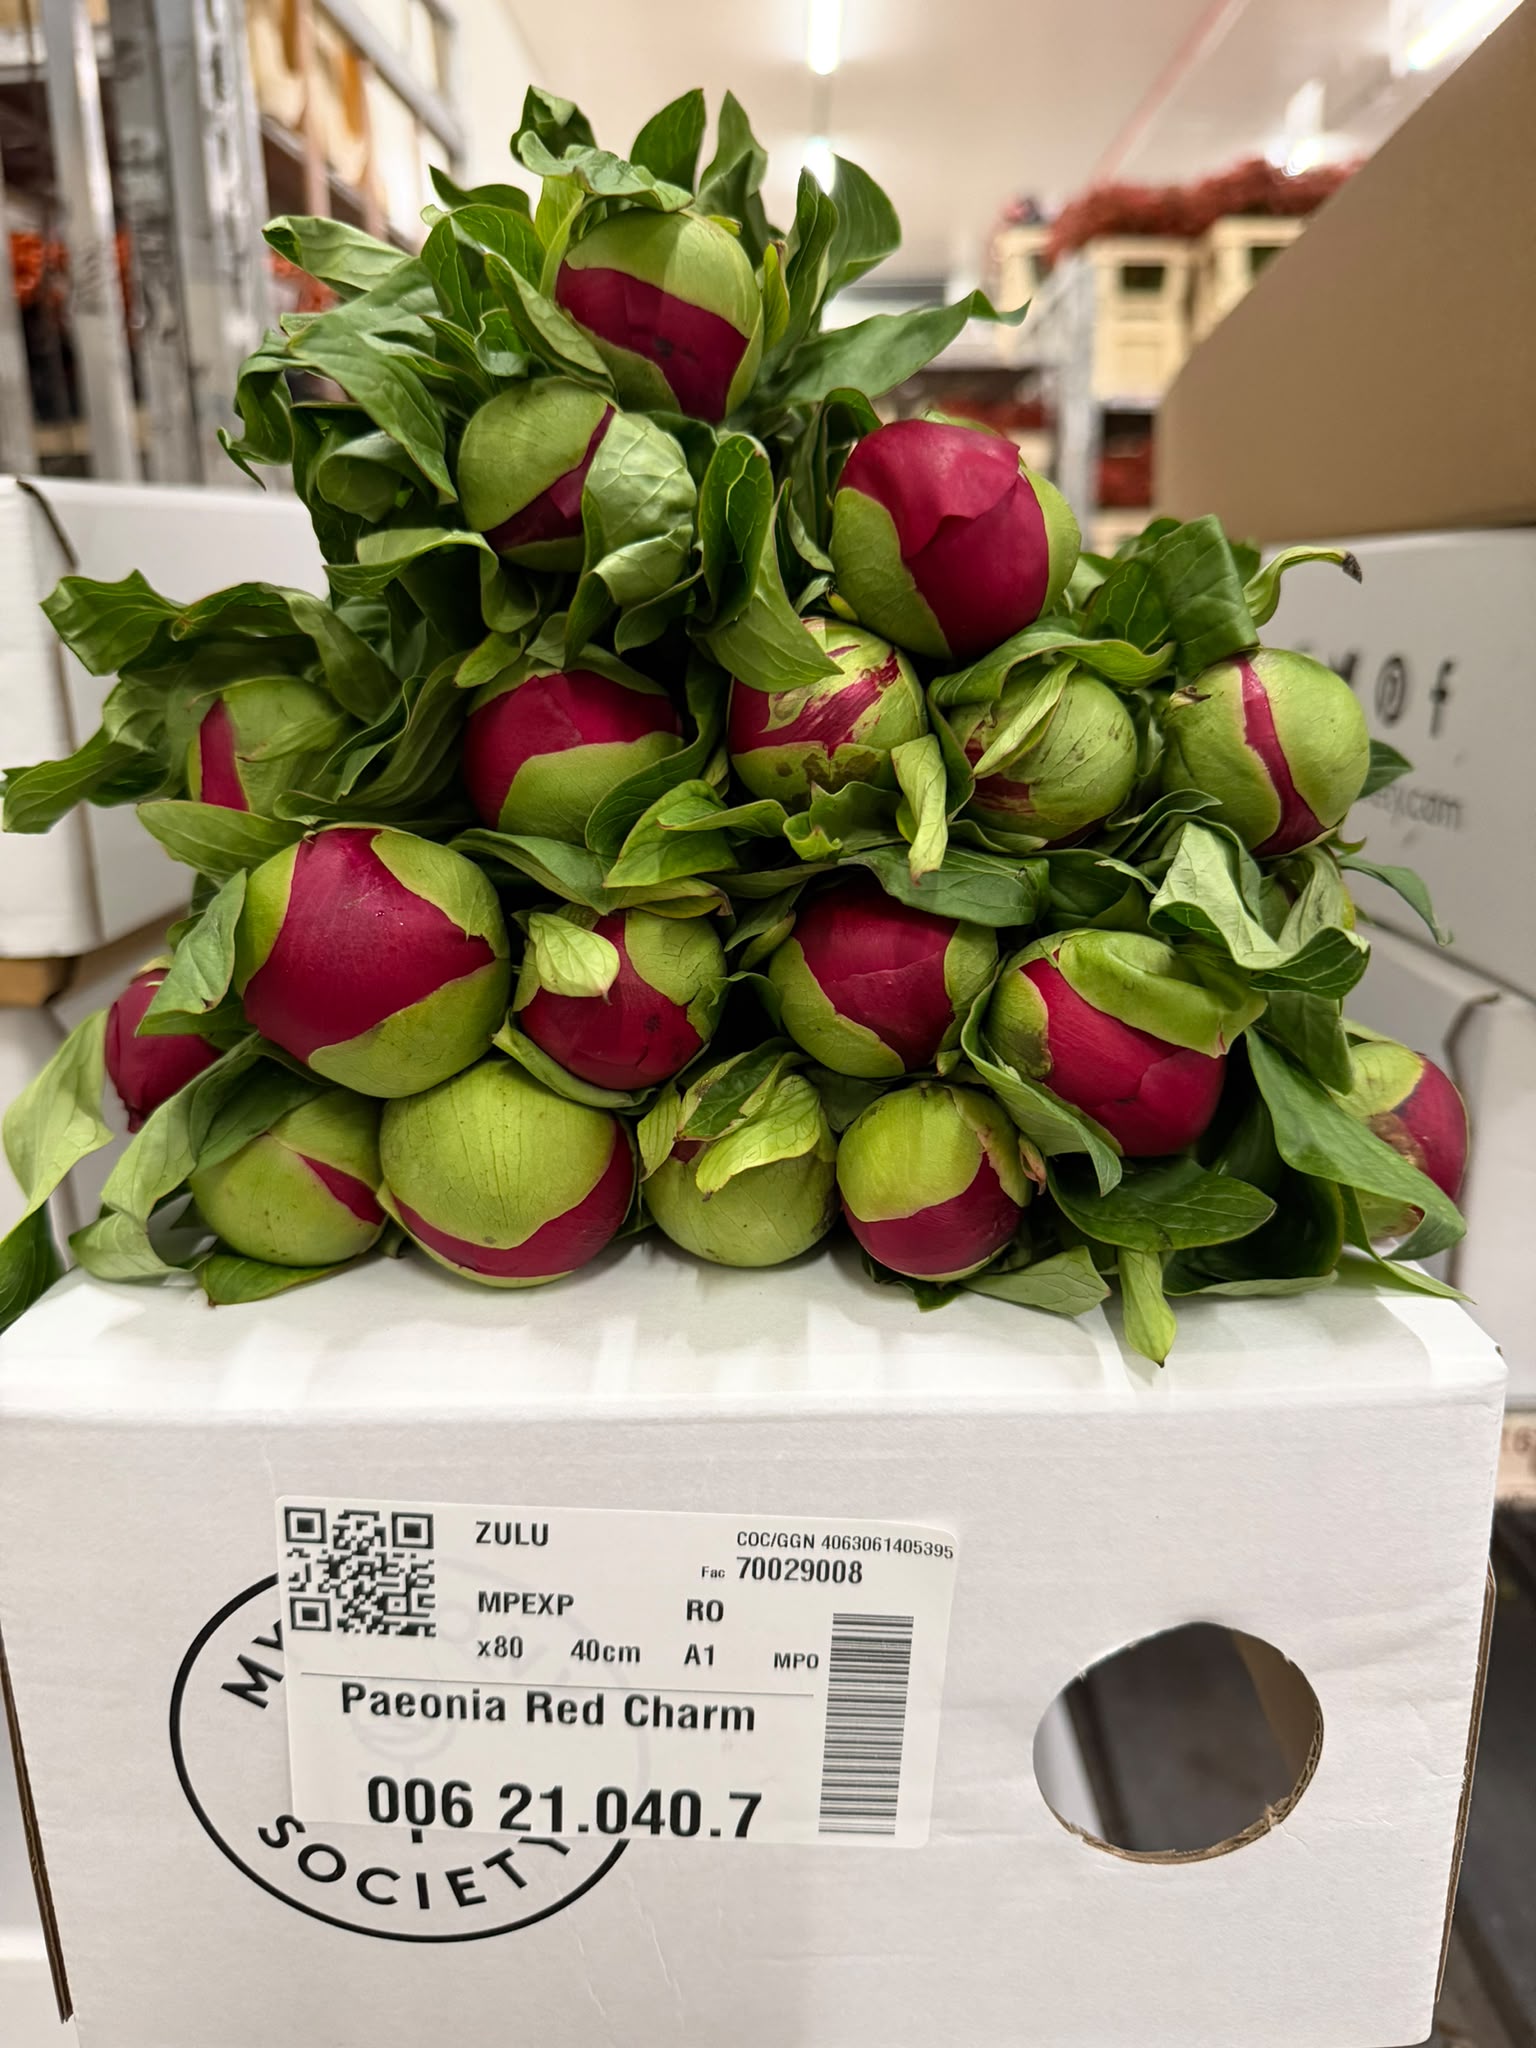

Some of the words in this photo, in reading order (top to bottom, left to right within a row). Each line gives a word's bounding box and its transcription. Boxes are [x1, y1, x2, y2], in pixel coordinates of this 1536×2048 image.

[474, 1519, 550, 1548] ZULU
[736, 1530, 815, 1550] COC/GGN
[821, 1533, 954, 1559] 4063061405395
[701, 1565, 726, 1579] Fac
[735, 1555, 864, 1585] 70029008
[477, 1590, 575, 1617] MPEXP
[685, 1598, 725, 1623] RO
[476, 1634, 524, 1660] x80
[569, 1638, 642, 1665] 40cm
[683, 1642, 715, 1668] A1
[341, 1681, 507, 1723] Paeonia
[526, 1689, 605, 1727] Red
[623, 1693, 756, 1733] Charm
[367, 1774, 474, 1829] 006
[498, 1781, 763, 1840] 21.040.7
